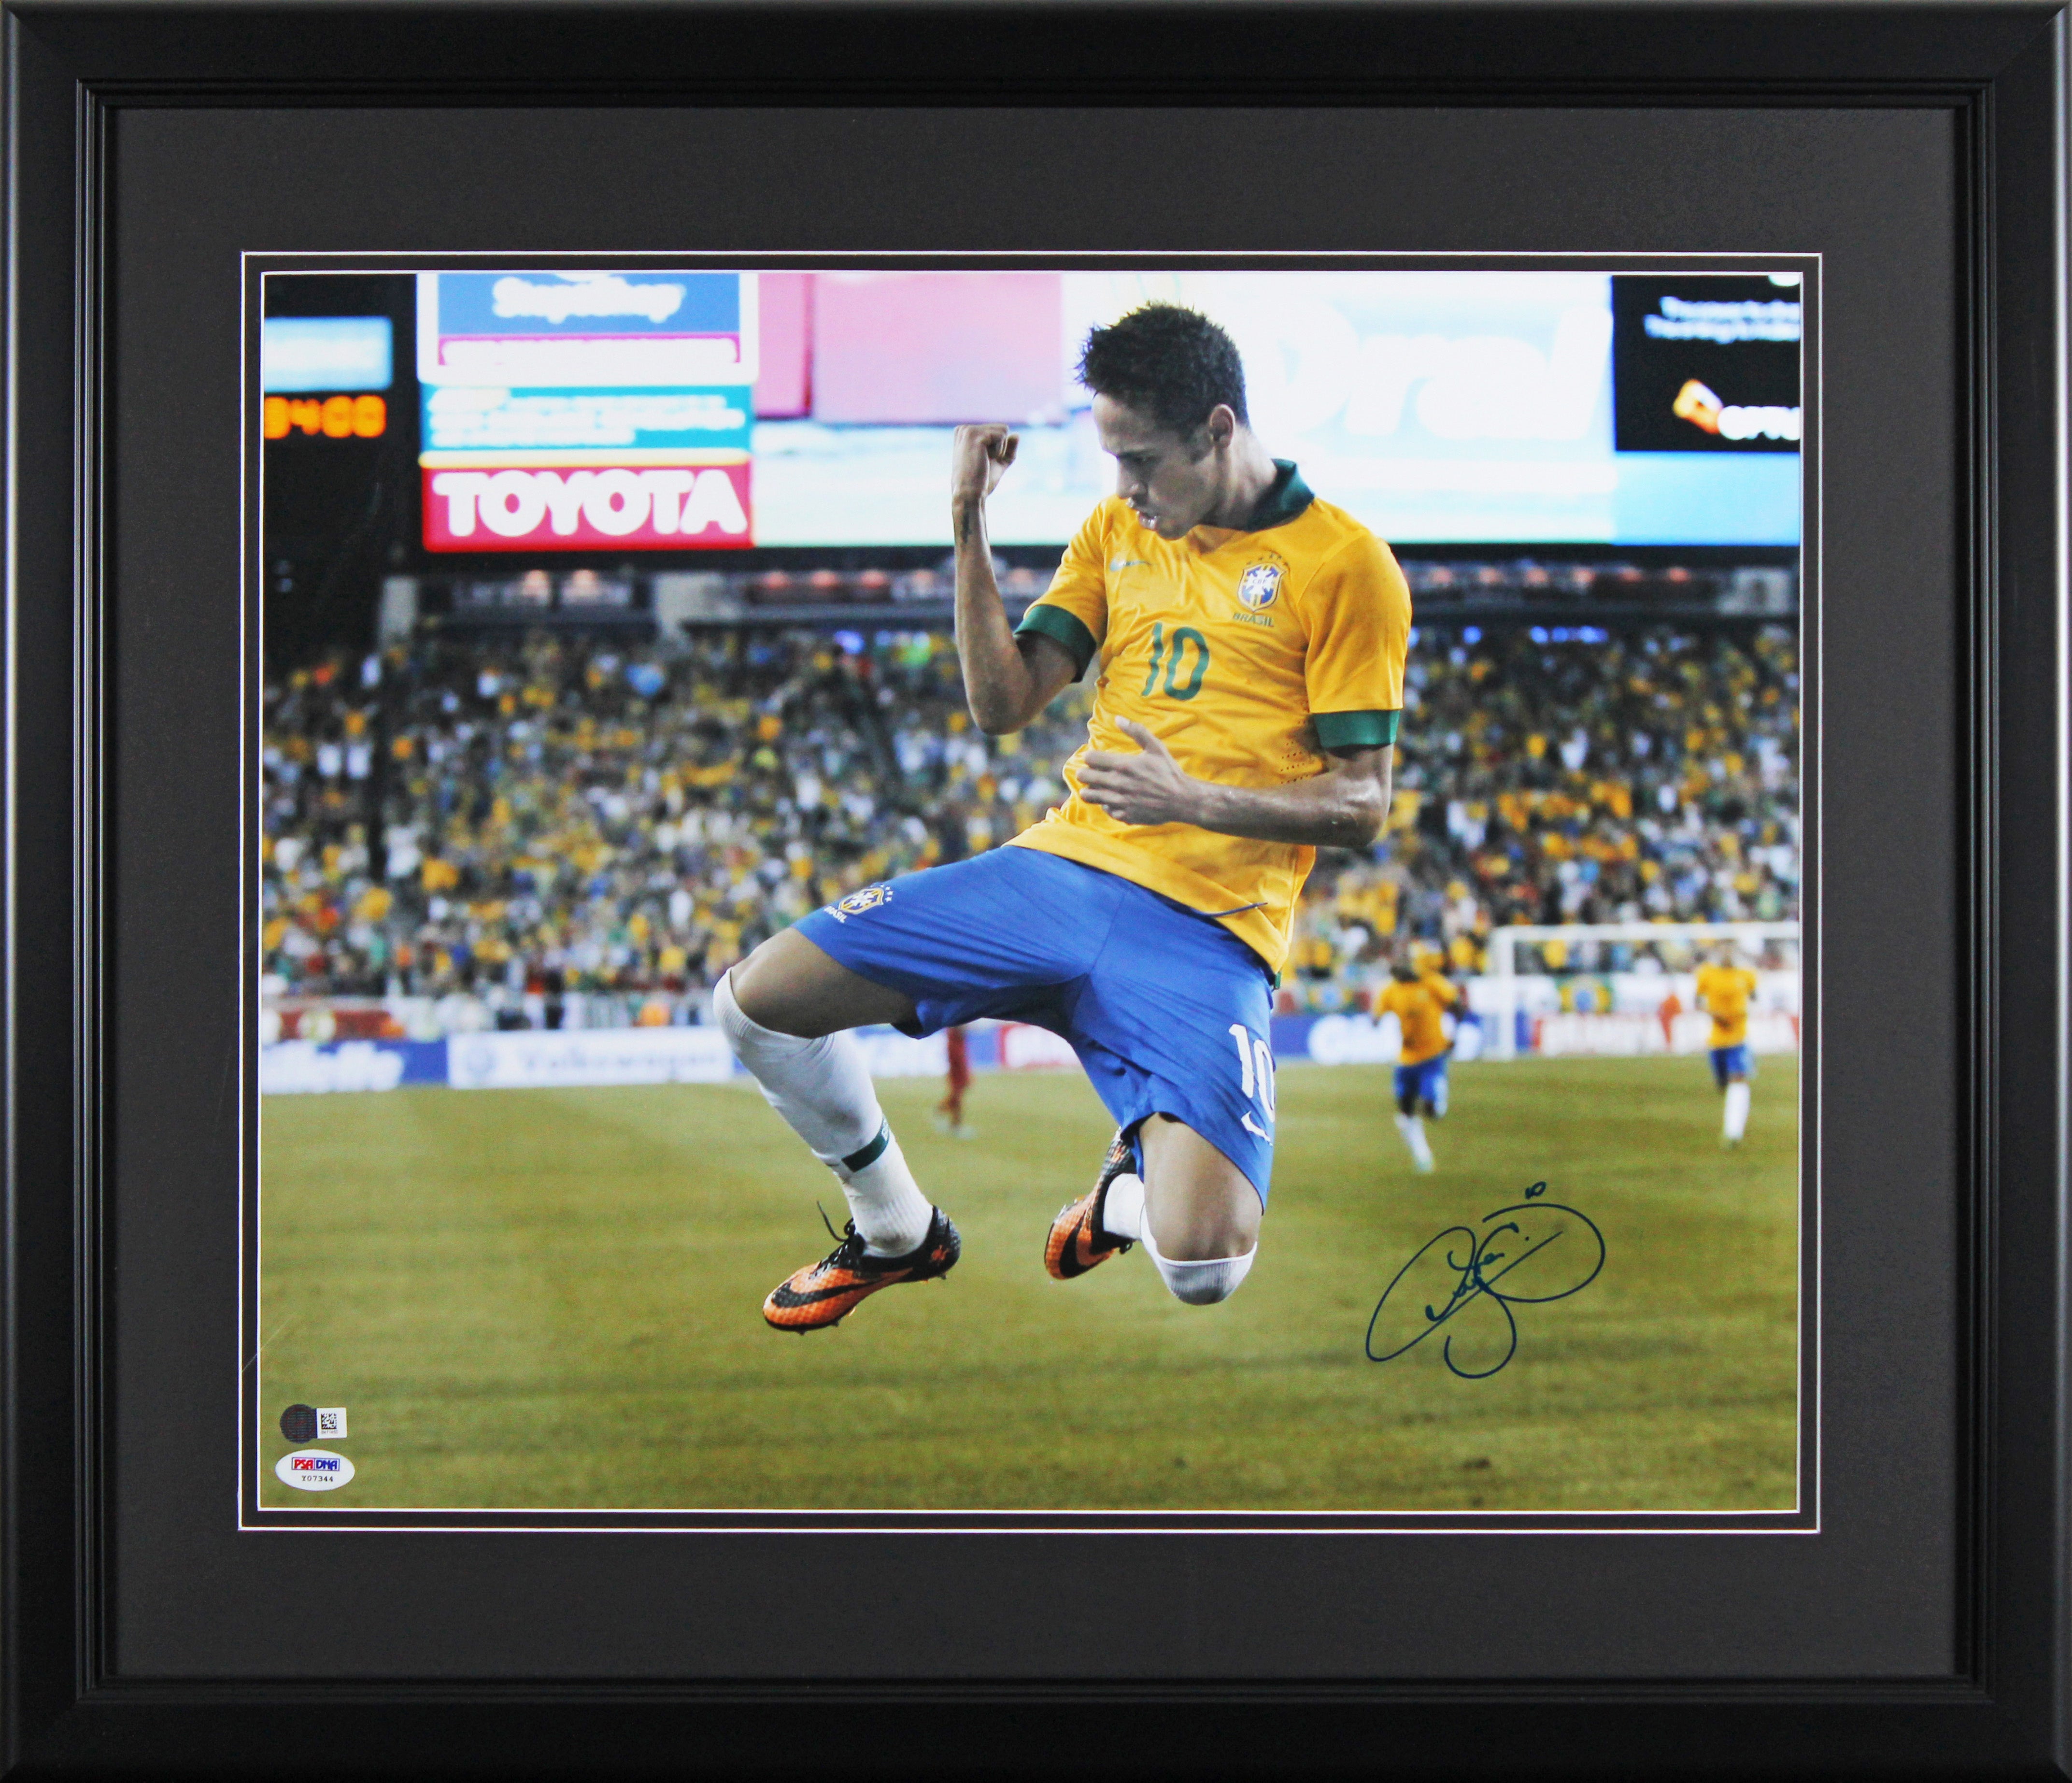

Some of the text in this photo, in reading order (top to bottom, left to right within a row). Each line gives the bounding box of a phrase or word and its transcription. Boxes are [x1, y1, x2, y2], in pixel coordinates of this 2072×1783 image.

[432, 469, 748, 537] TOYOTA
[1233, 612, 1275, 628] BRASIL
[1141, 622, 1210, 701] 10
[1228, 1023, 1275, 1123] 10
[294, 1459, 338, 1470] PSA DNA
